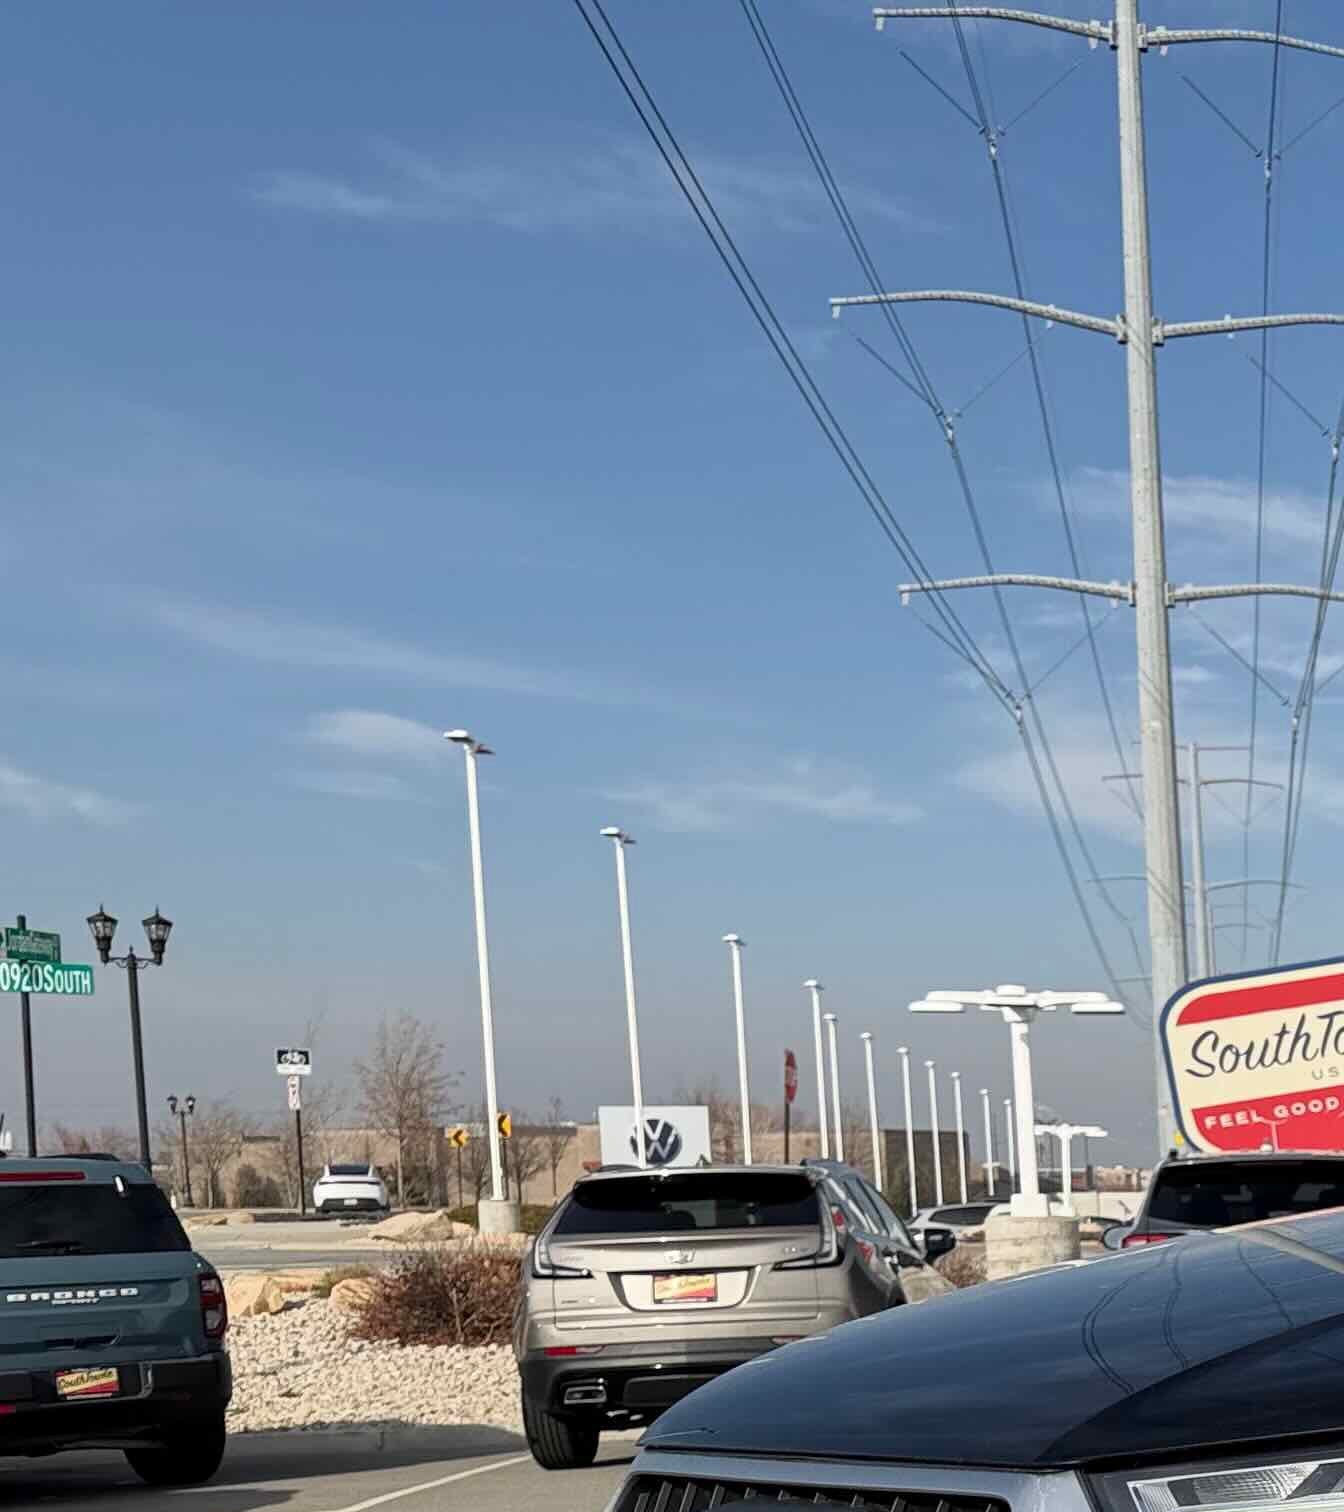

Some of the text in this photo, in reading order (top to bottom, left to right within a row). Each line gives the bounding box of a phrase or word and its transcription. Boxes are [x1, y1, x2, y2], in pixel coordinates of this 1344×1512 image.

[43, 964, 91, 993] SOUTH
[1204, 1108, 1264, 1130] FEEL
[1273, 1096, 1341, 1119] GOOD
